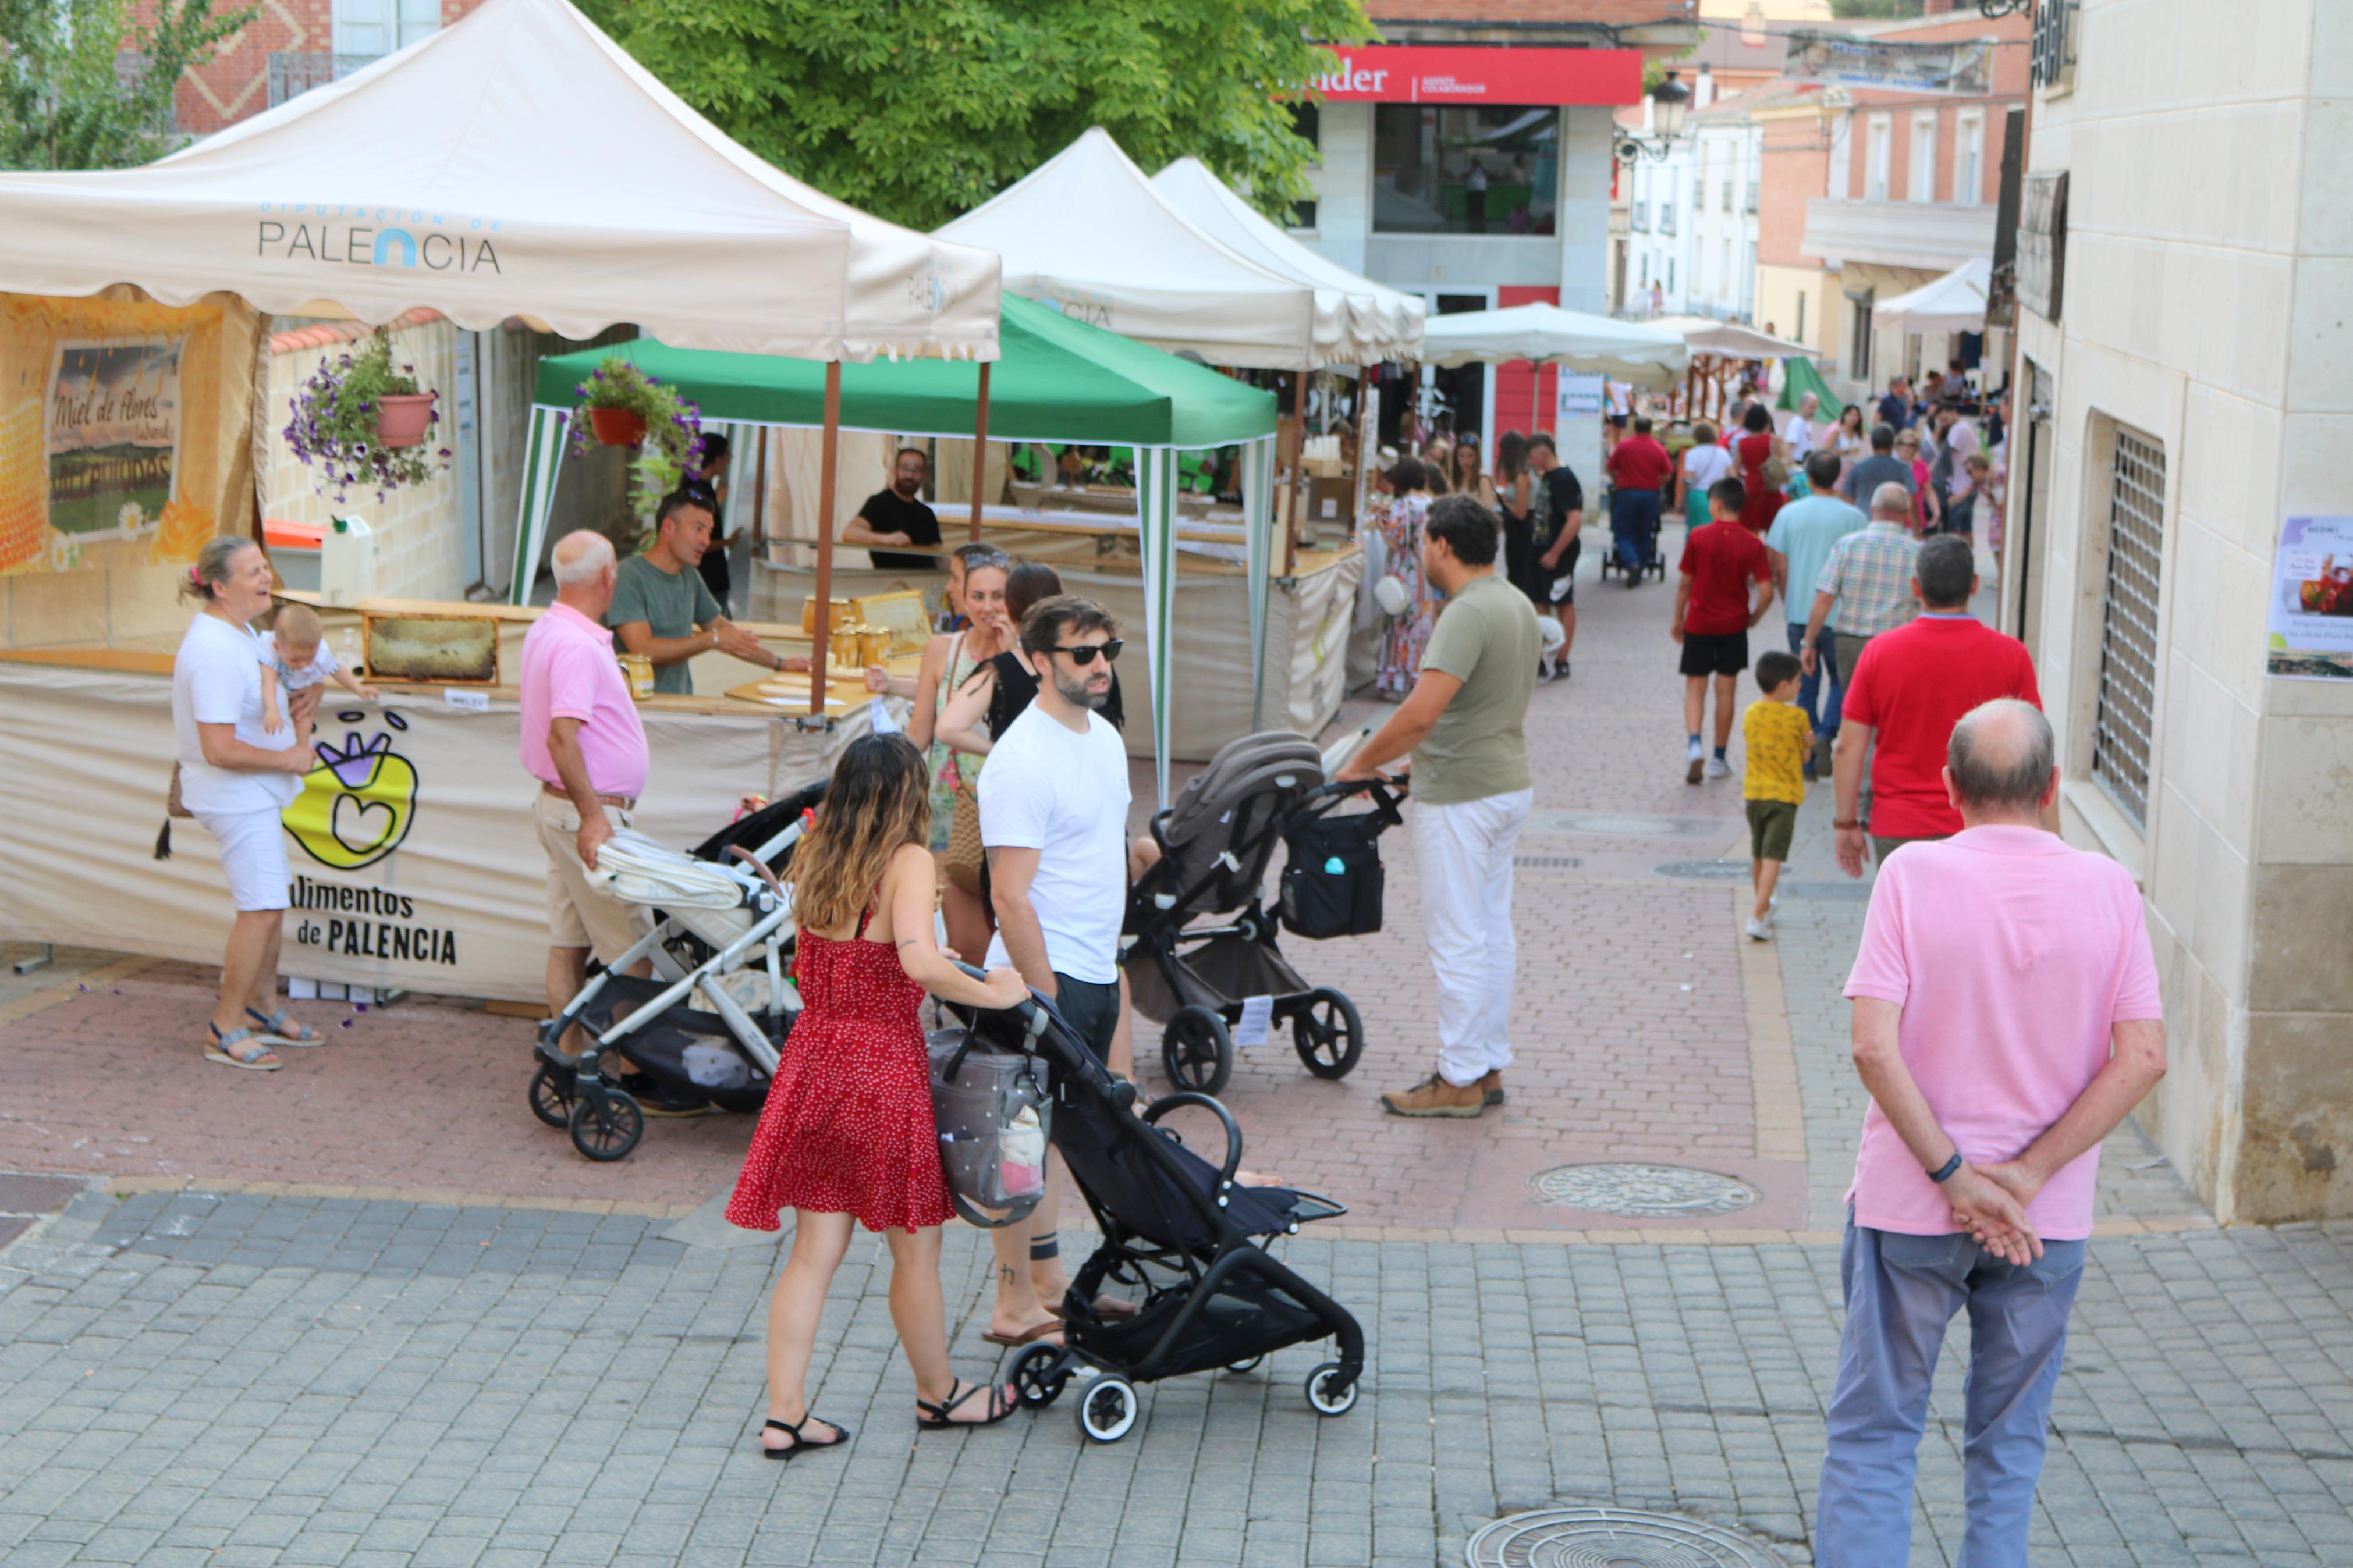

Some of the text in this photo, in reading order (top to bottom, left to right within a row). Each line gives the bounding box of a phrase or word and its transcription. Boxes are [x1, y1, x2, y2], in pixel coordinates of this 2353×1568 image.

[470, 218, 502, 232] DE
[56, 390, 94, 429] Miel
[96, 390, 114, 422] de
[297, 919, 457, 965] de PALENCIA
